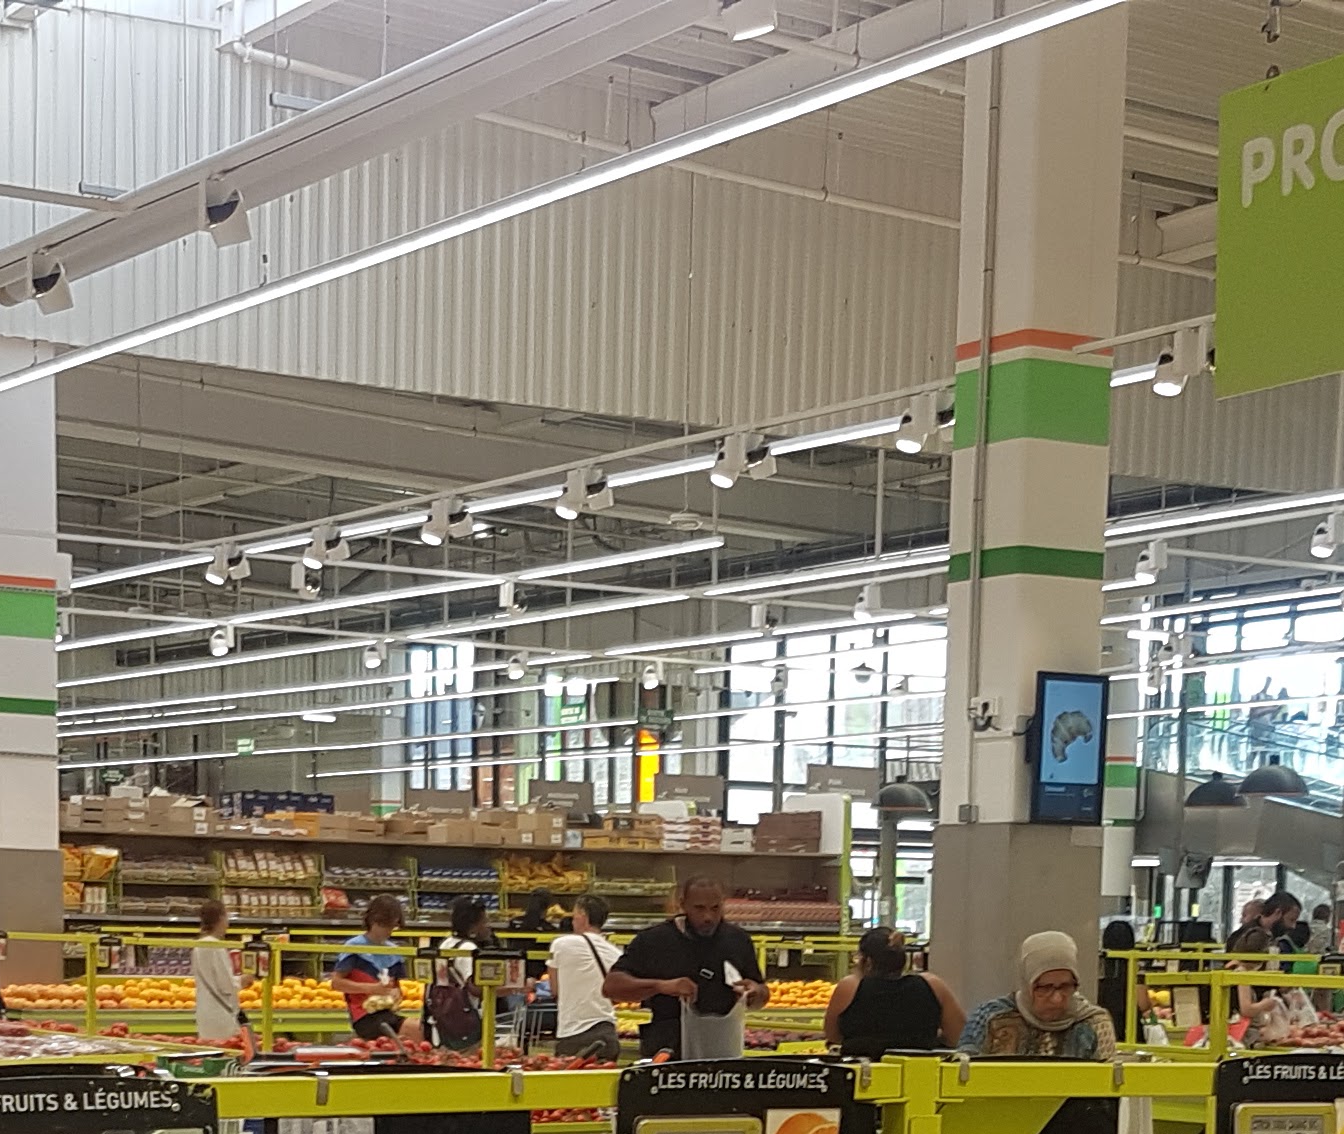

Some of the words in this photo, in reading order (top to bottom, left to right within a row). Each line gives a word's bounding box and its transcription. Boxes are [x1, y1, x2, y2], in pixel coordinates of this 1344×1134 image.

[659, 1073, 685, 1088] LES
[689, 1072, 739, 1088] FRUITS
[744, 1073, 754, 1088] &
[758, 1069, 824, 1089] LÉGUMES
[1249, 1064, 1271, 1079] LES
[1273, 1065, 1316, 1079] FRUITS
[1318, 1066, 1327, 1079] &
[64, 1093, 77, 1111] &
[83, 1088, 172, 1110] LÉGUMES
